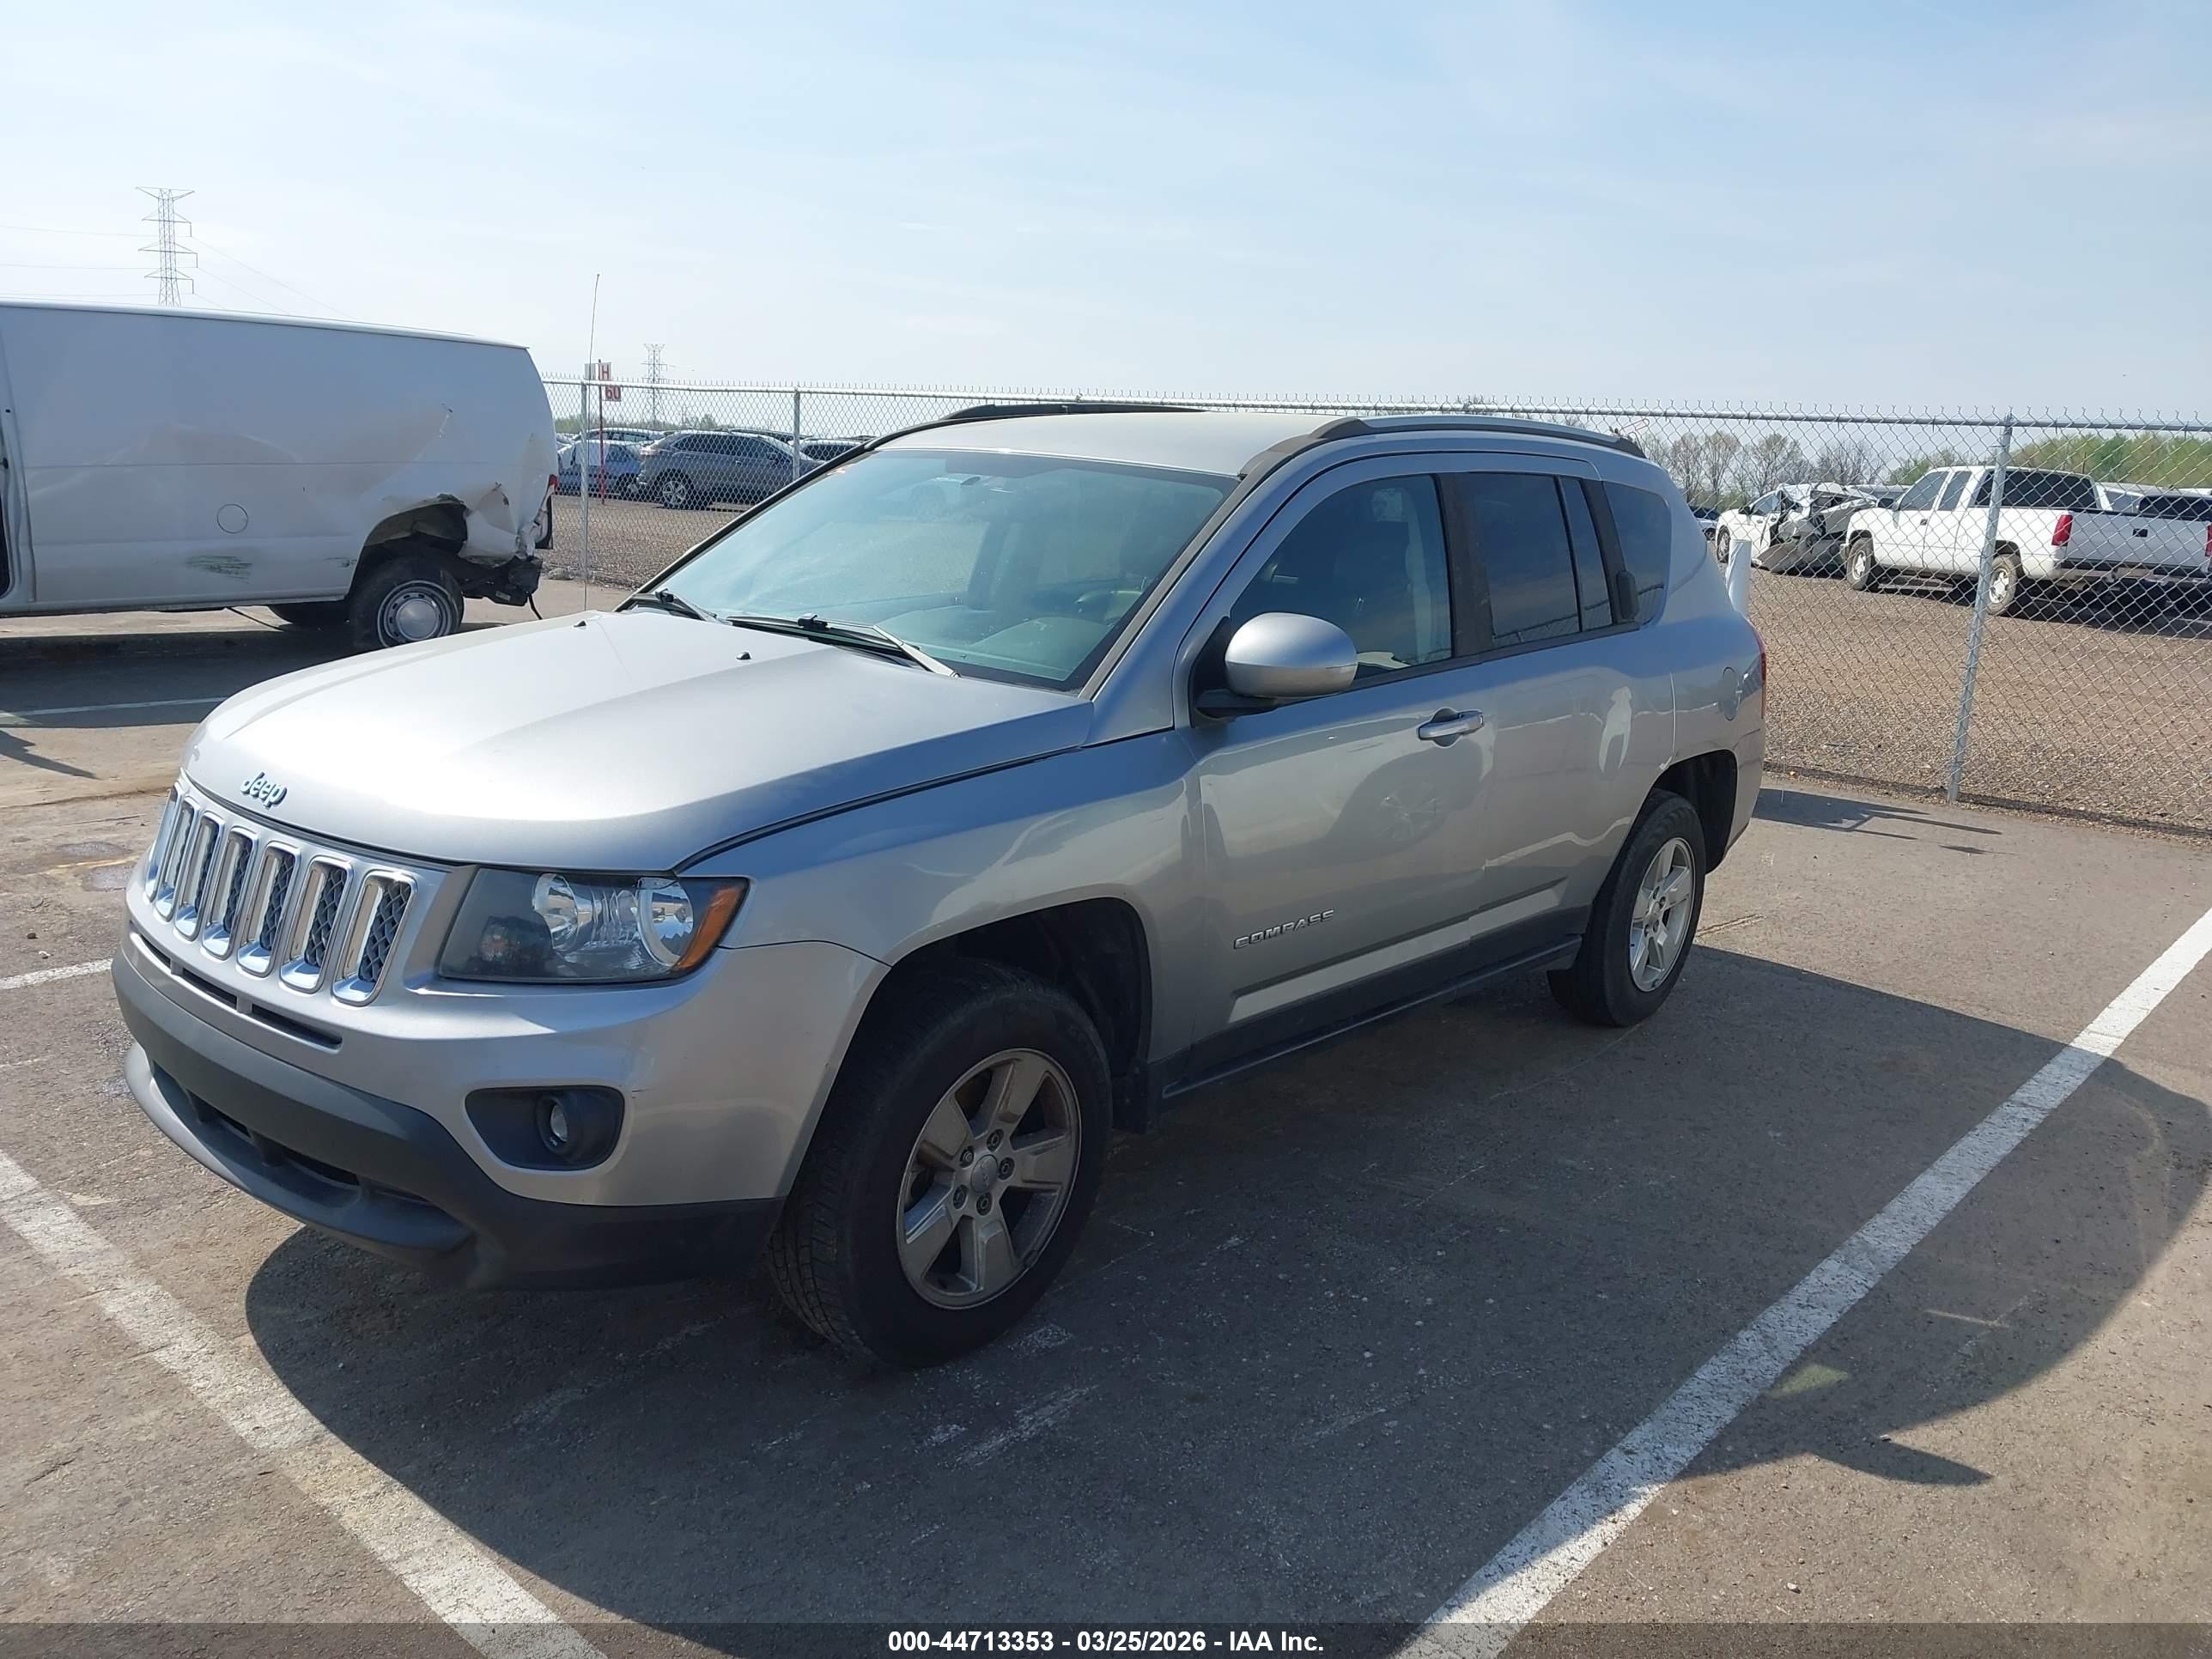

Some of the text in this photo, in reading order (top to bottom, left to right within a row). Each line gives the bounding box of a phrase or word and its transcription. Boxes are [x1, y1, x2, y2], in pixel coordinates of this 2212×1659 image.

[602, 363, 610, 380] H
[605, 385, 621, 399] 60
[240, 771, 288, 810] Jeep
[1234, 909, 1334, 949] COMPASS
